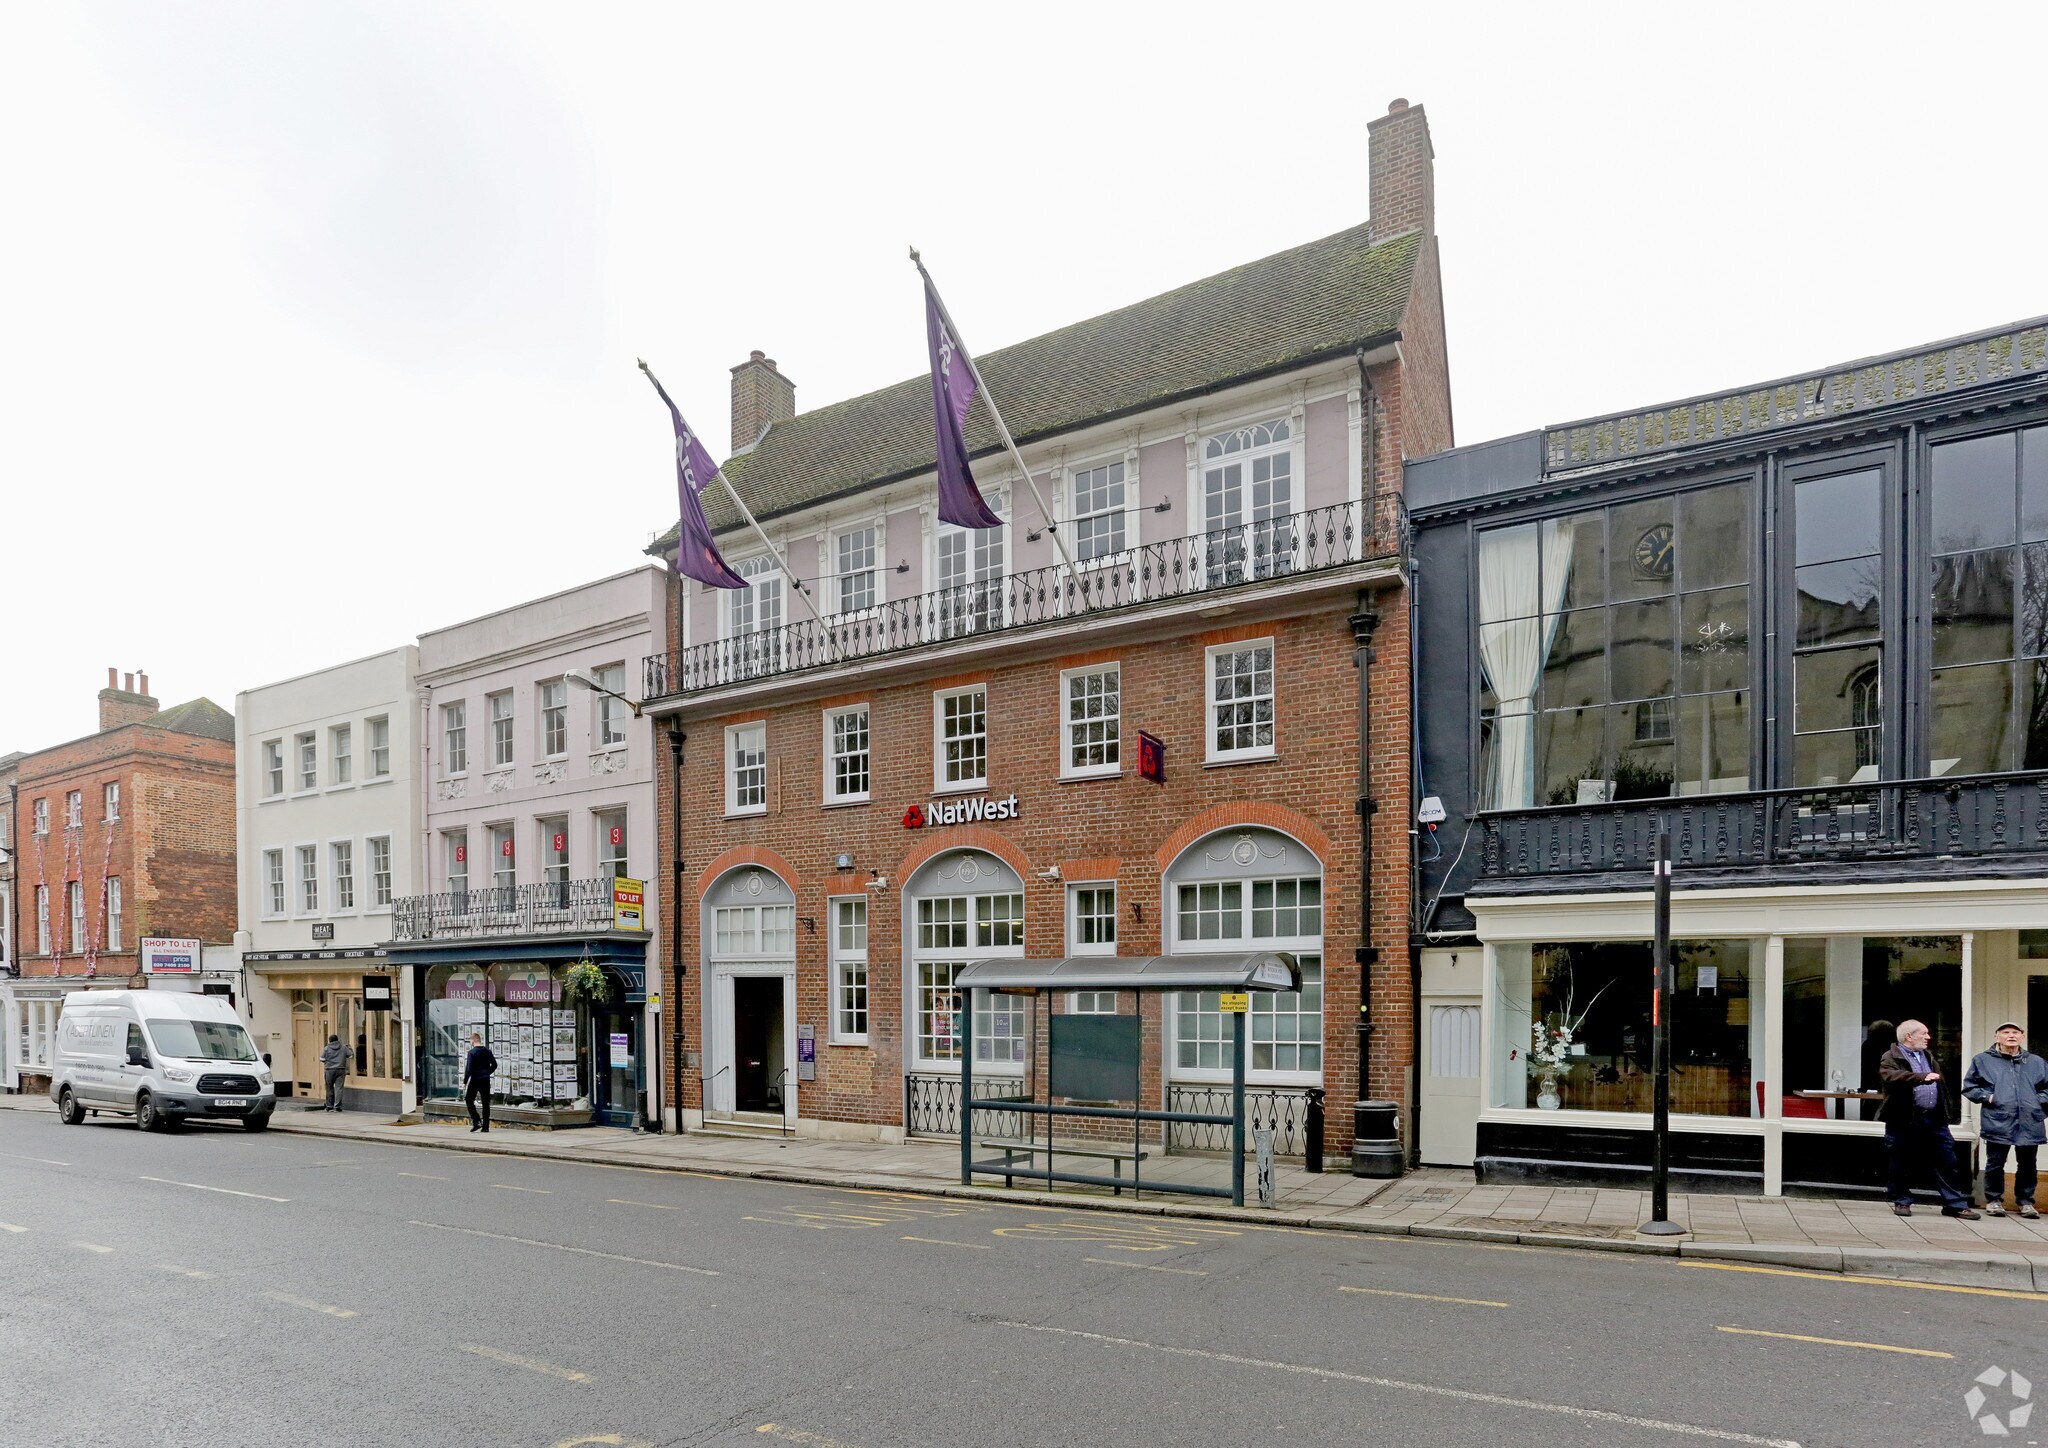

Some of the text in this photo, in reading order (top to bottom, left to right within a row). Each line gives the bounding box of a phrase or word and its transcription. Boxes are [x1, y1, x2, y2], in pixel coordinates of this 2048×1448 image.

[928, 794, 1018, 826] NatWest
[618, 893, 639, 902] TO LET
[314, 925, 330, 933] MEAT
[450, 990, 491, 999] HARDINGS
